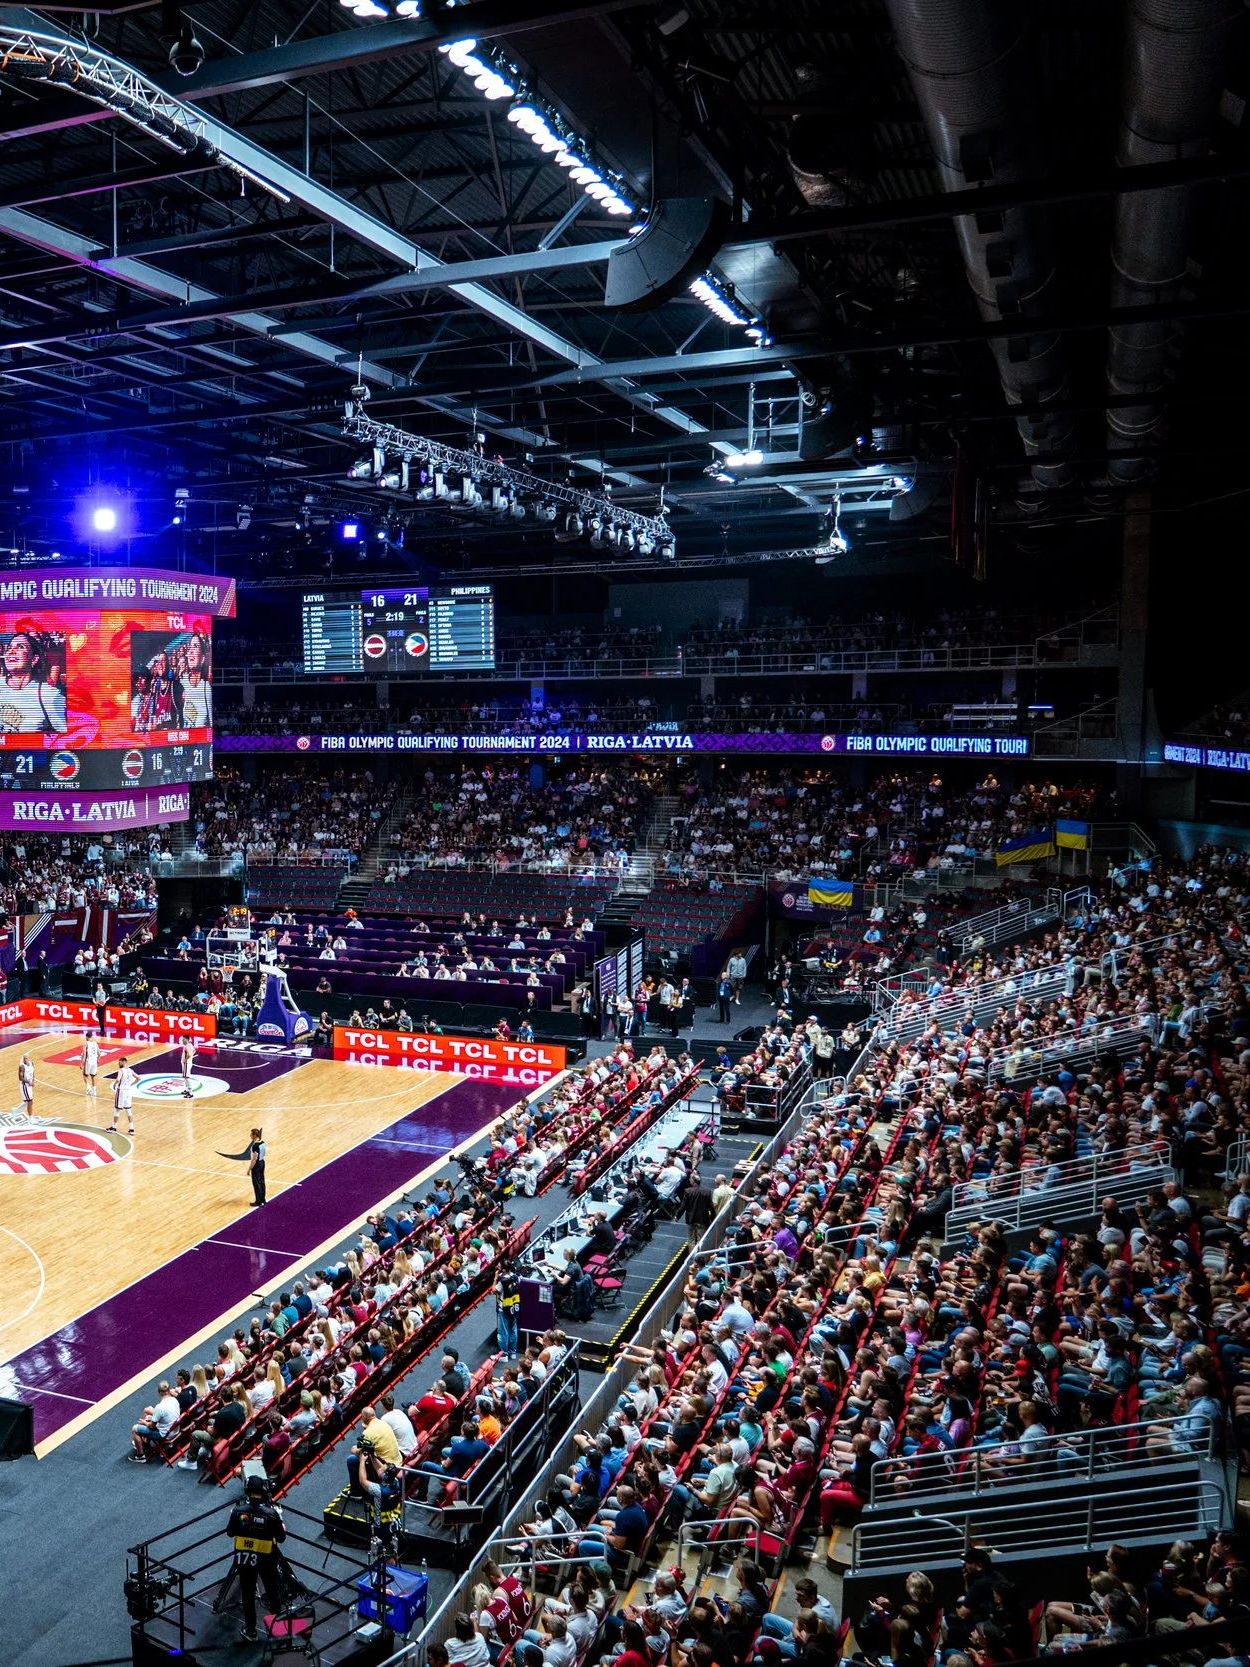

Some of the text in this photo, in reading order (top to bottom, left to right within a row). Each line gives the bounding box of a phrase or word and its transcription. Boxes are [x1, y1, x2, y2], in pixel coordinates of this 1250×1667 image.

[41, 578, 136, 600] QUALIFYING
[140, 578, 197, 603] TOURNAMENT
[198, 585, 218, 604] 2024
[404, 593, 417, 605] 21
[451, 586, 490, 595] PHILIPPINES
[371, 595, 385, 607] 16
[167, 616, 186, 629] TCL
[386, 612, 404, 621] 2:19
[321, 737, 345, 749] FIBA
[350, 737, 394, 749] OLYMPIC
[398, 736, 448, 749] QUALIFYING
[452, 736, 536, 749] TOURNAMENT
[540, 736, 570, 750] 2024
[846, 736, 872, 751] FIBA
[876, 737, 927, 752] OLYMPIC
[931, 738, 991, 753] QUALIFYING
[15, 755, 33, 773] 21
[151, 753, 162, 770] 16
[193, 749, 203, 766] 21
[0, 1005, 22, 1022] TCL
[36, 1003, 73, 1019] TCL
[121, 1011, 160, 1027] TCL
[165, 1015, 204, 1031] TCL
[200, 1037, 312, 1056] RIGA
[345, 1032, 552, 1064] TCL TCL TCL TCL
[235, 1552, 258, 1567] 173
